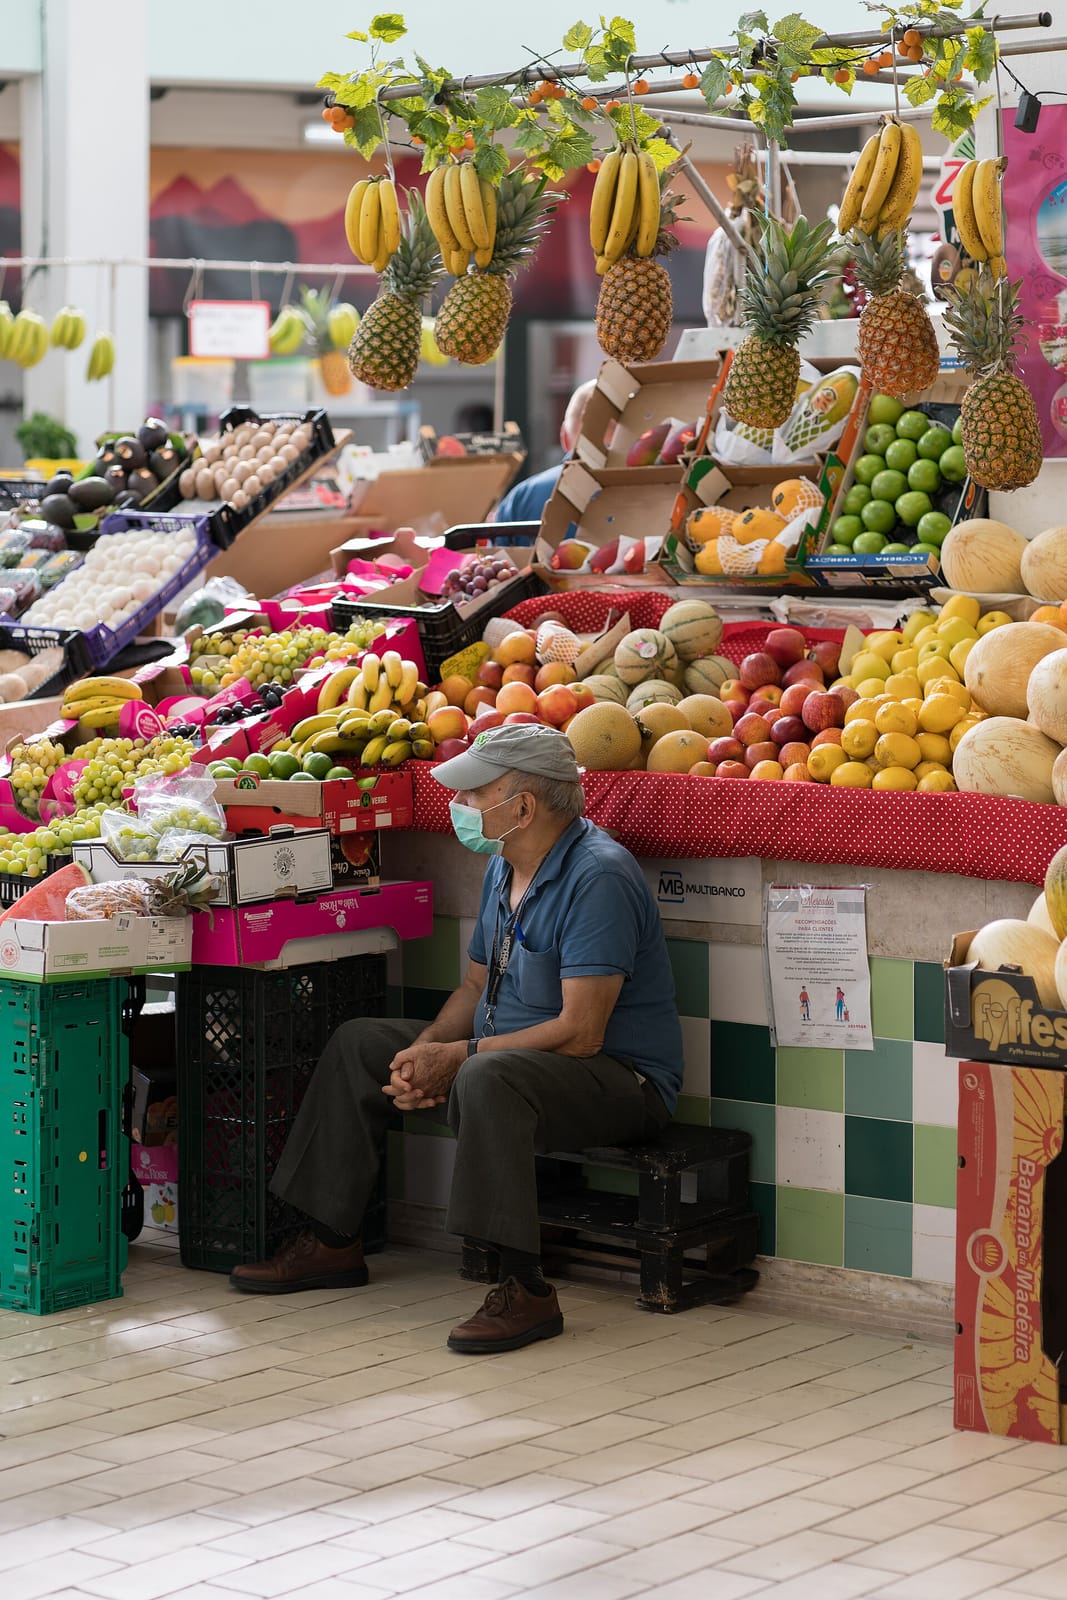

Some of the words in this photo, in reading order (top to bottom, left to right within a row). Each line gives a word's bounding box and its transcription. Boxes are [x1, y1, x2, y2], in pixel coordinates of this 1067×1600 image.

[371, 795, 388, 805] VERDE
[685, 884, 746, 897] MULTIBANCO
[319, 900, 338, 912] Rosa
[1018, 1156, 1036, 1247] Banana
[1018, 1250, 1029, 1266] da
[1016, 1269, 1034, 1362] Madeira
